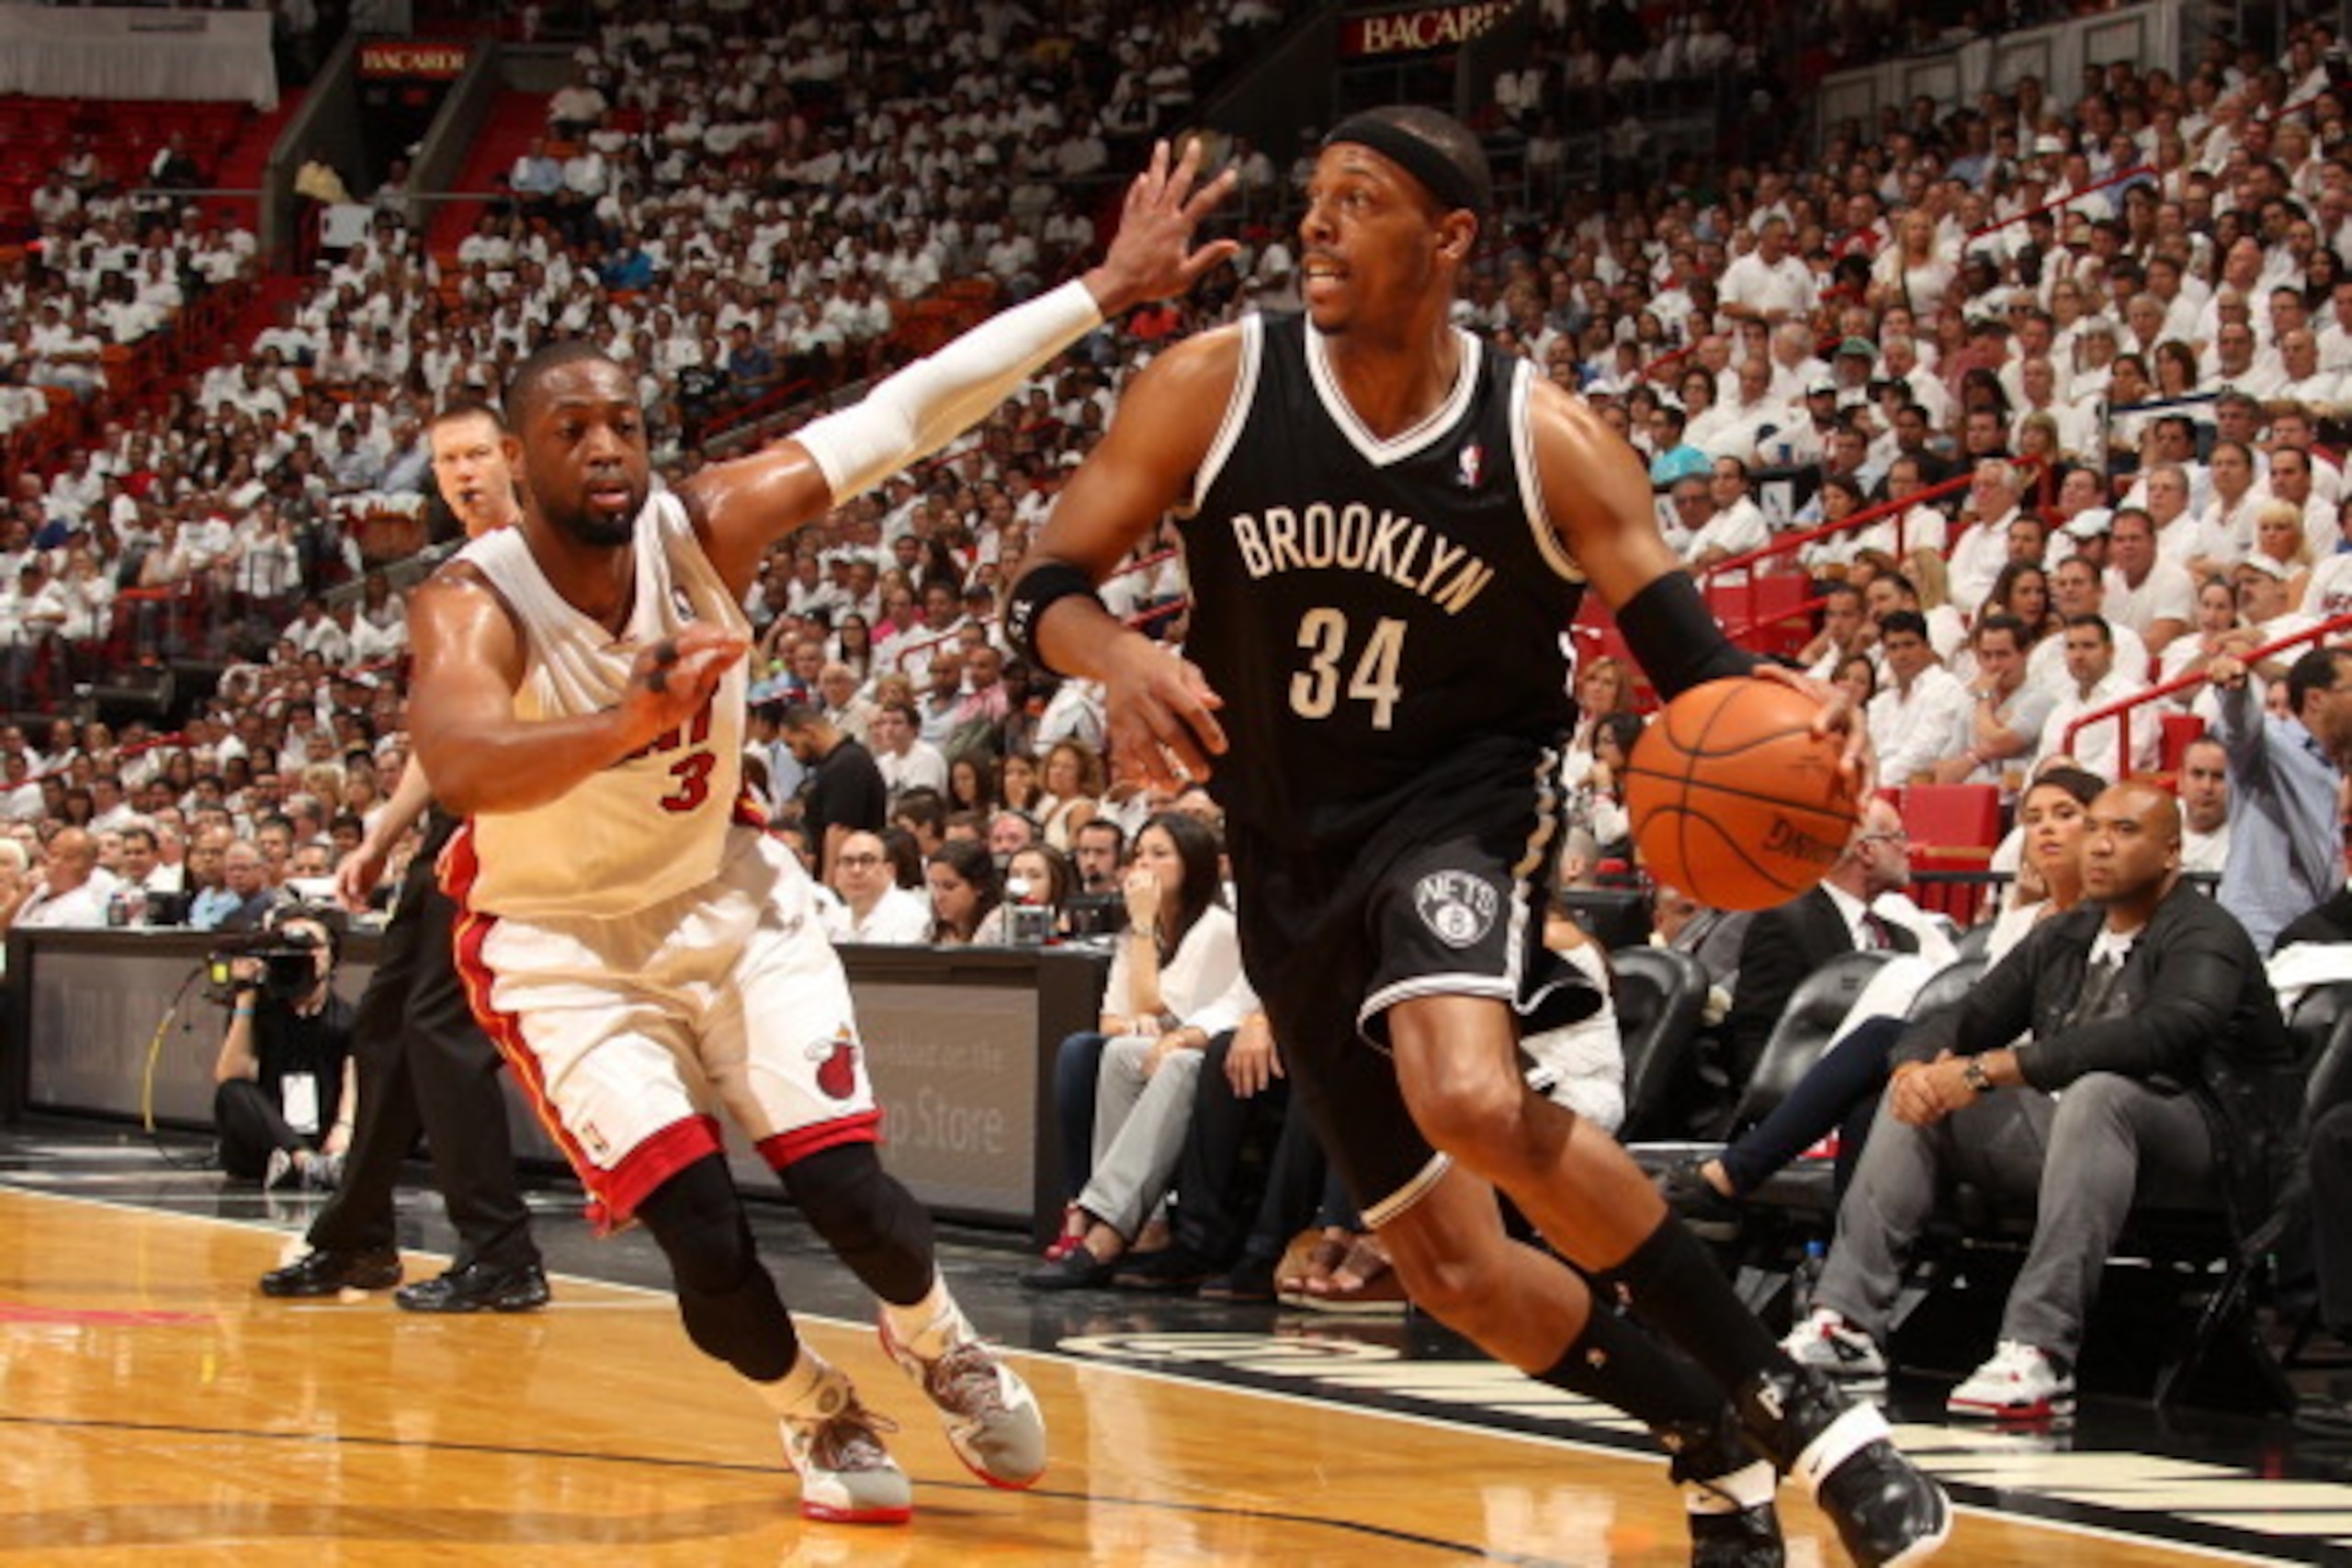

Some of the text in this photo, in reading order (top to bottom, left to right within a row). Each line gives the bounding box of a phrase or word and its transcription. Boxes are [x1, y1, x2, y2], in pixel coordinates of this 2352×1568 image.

[1231, 502, 1495, 615] BROOKLYN
[1289, 606, 1408, 730] 34
[660, 752, 716, 812] 3
[1417, 875, 1494, 917] NETS
[915, 1084, 1005, 1156] Store
